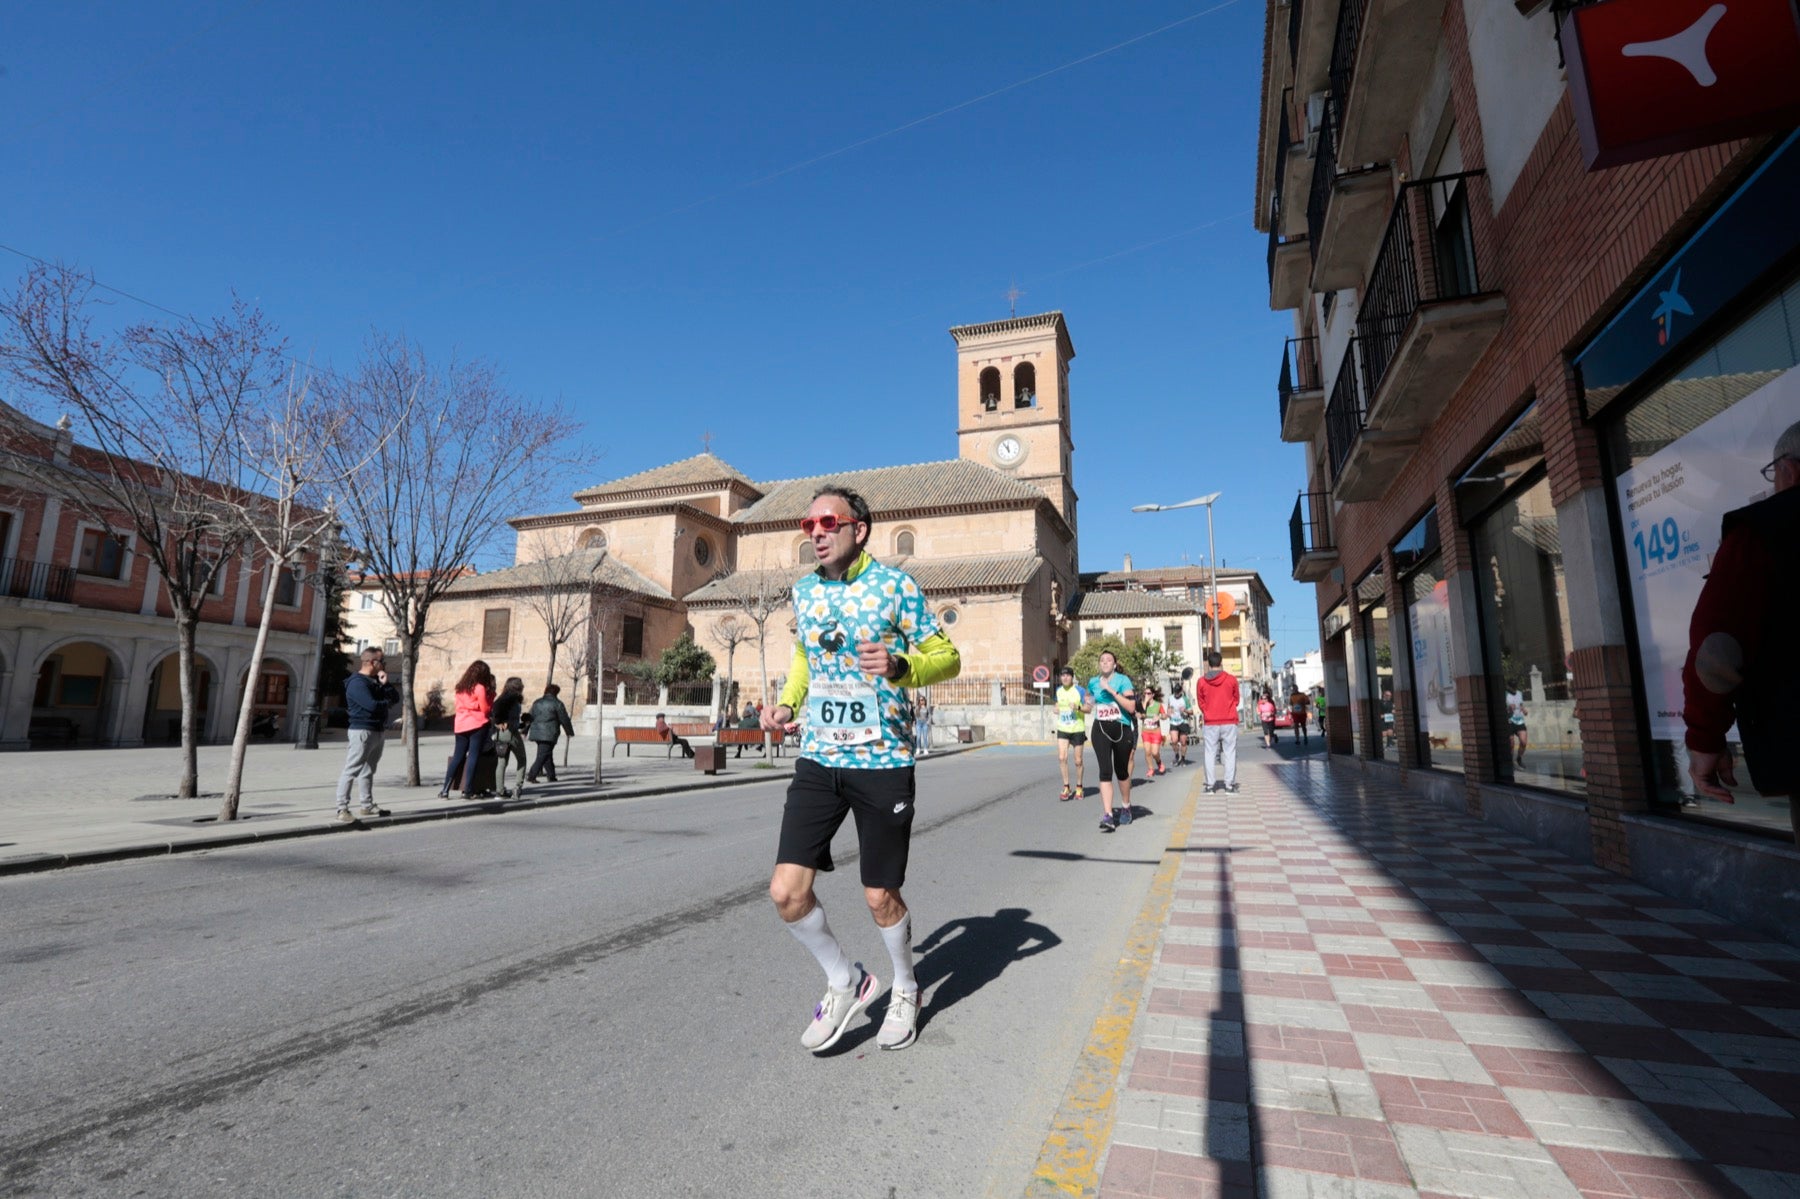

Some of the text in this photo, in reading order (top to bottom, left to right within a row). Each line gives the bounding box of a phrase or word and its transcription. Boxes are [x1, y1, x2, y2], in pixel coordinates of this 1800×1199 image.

[1626, 462, 1683, 498] Renueva tu hogar,
[1627, 492, 1652, 512] renueva
[1652, 489, 1661, 498] tu
[1634, 517, 1680, 570] 149
[821, 701, 866, 724] 678
[1099, 708, 1120, 718] 2244
